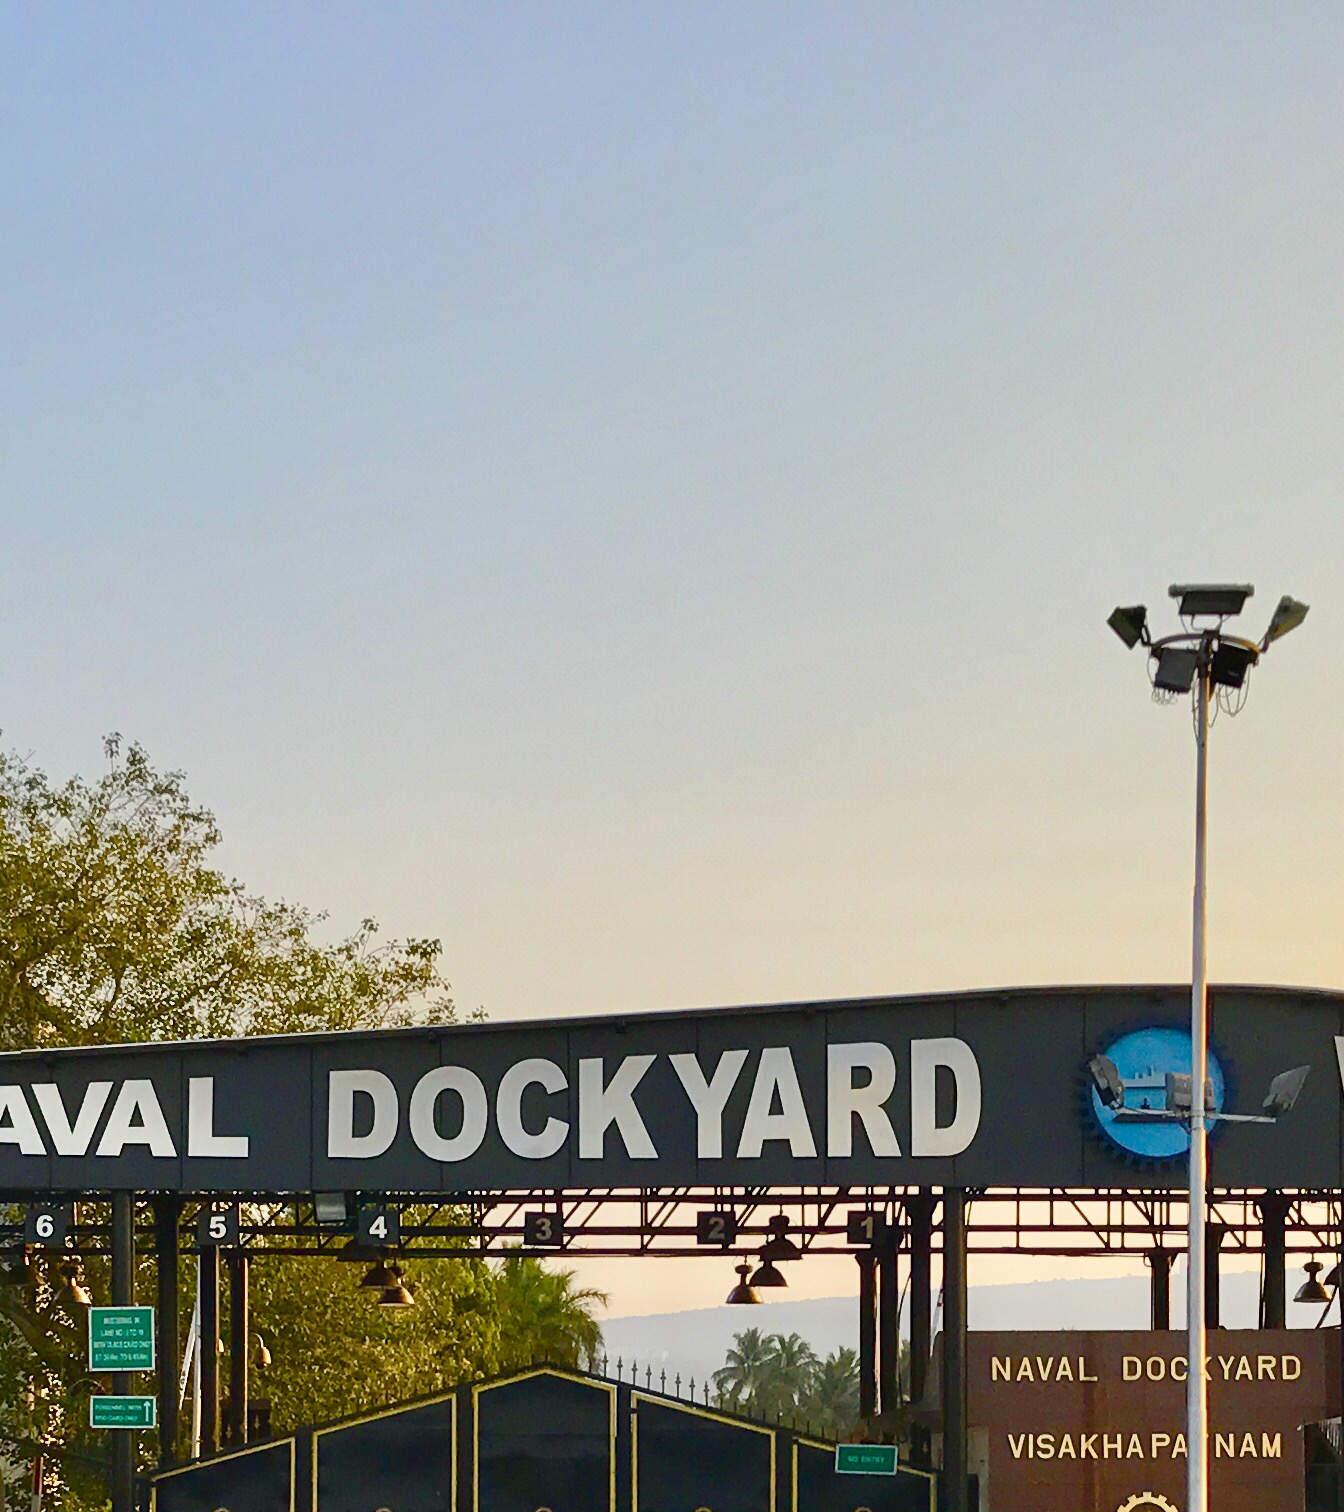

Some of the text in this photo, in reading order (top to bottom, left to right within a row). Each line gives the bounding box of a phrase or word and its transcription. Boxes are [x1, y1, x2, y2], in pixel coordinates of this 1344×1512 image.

[327, 1037, 982, 1162] DOCKYARD
[35, 1214, 54, 1238] 6
[208, 1216, 227, 1239] 5
[368, 1215, 388, 1239] 4
[535, 1217, 554, 1241] 3
[707, 1216, 726, 1240] 2
[860, 1216, 874, 1239] 1
[991, 1356, 1098, 1382] NAVAL
[1007, 1432, 1282, 1460] VISAKHAPANAM
